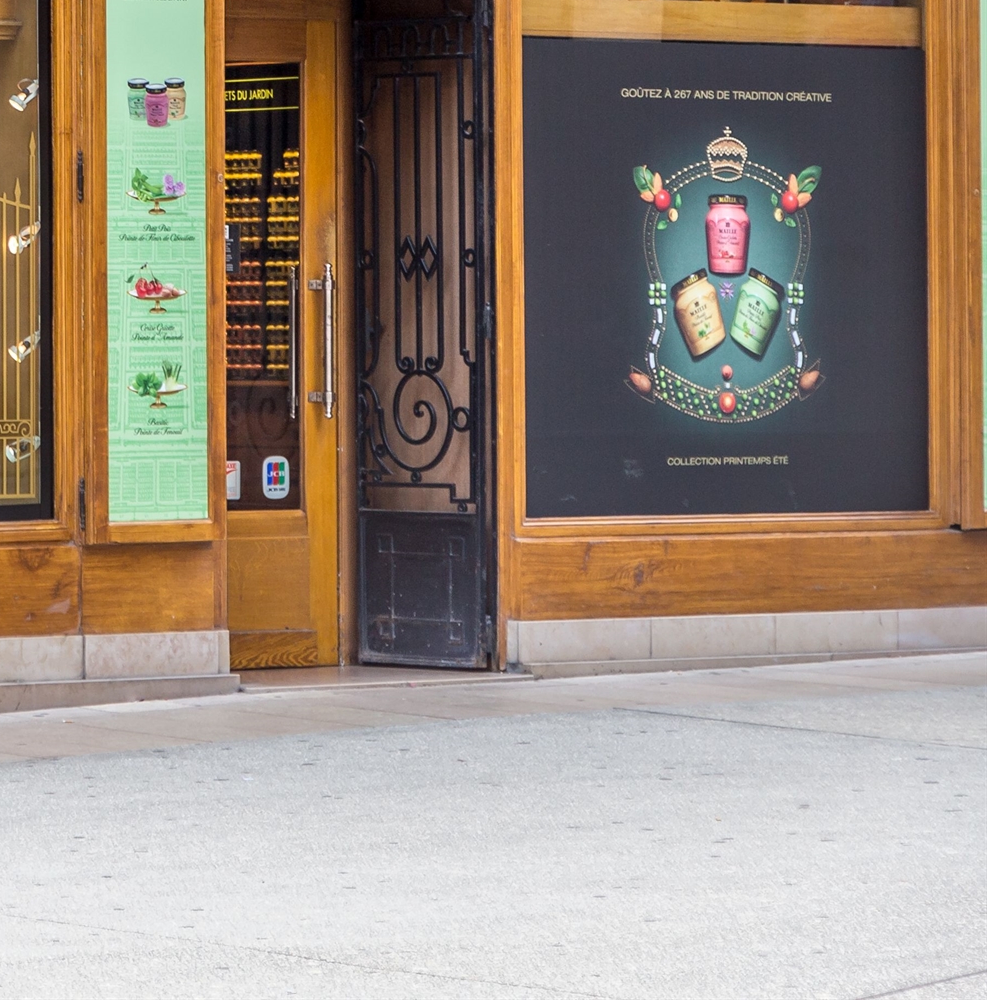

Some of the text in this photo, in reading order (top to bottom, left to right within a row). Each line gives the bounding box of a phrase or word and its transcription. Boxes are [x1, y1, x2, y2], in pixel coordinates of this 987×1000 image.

[237, 90, 248, 100] DU
[249, 88, 274, 100] JARDIN
[621, 86, 832, 102] GOÛTEZ À 267 ANS DE TRADITION CRÉATIVE
[666, 454, 789, 466] COLLECTION PRINTEMPS ÉTÉ
